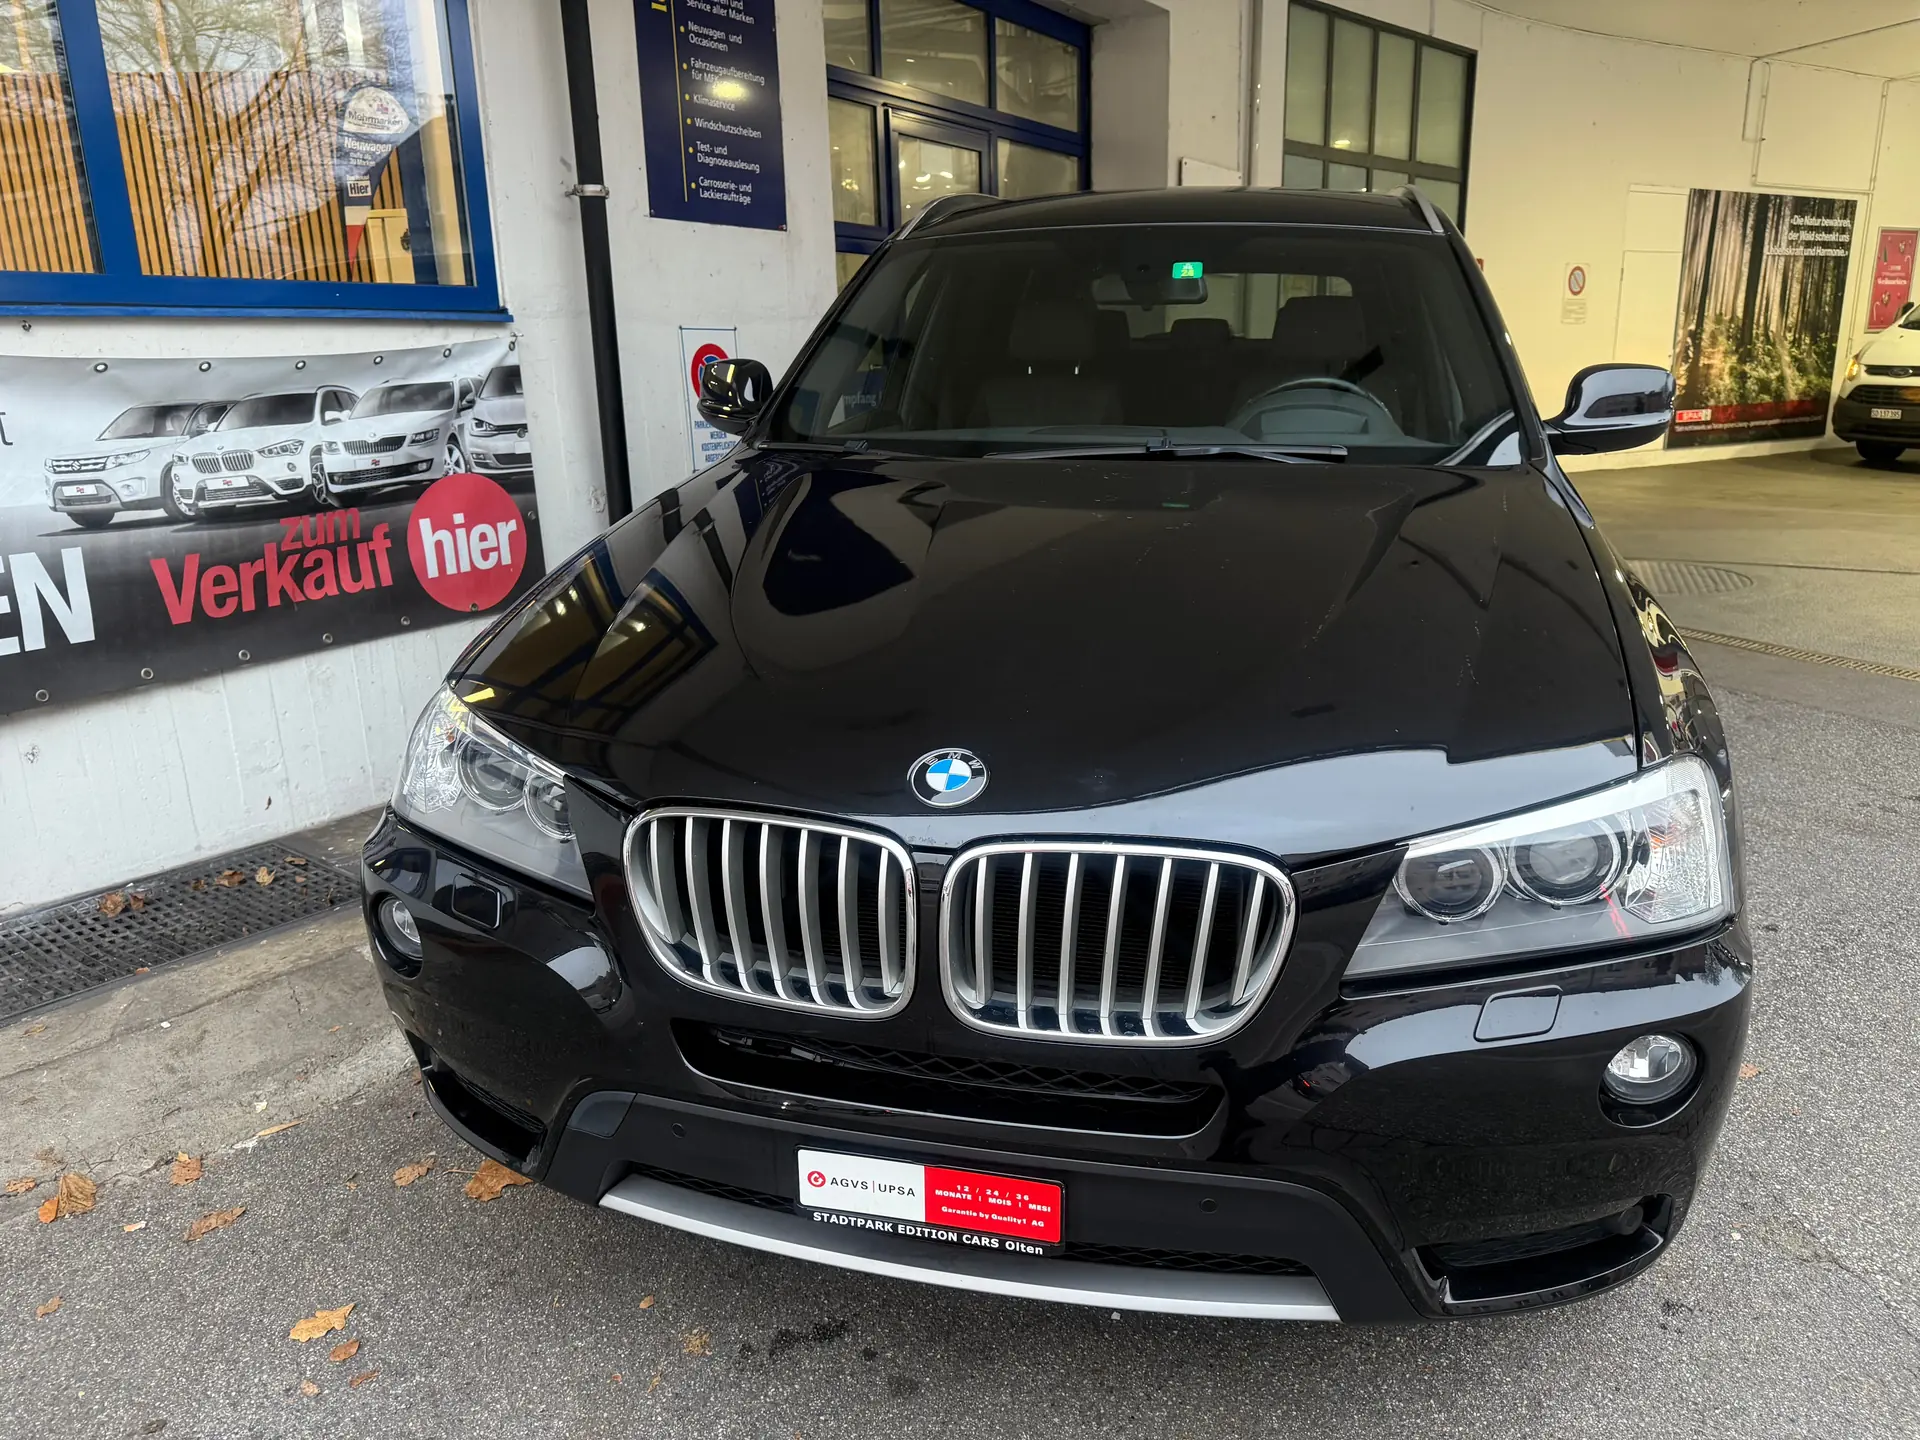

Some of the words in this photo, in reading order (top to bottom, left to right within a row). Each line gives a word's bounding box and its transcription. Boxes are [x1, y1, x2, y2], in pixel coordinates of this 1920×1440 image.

[686, 0, 712, 12] Service
[712, 4, 728, 16] aller
[729, 9, 754, 24] Marken
[688, 21, 726, 40] Neuwagen
[728, 34, 742, 44] und
[688, 33, 728, 52] Occasionen
[690, 58, 765, 86] Fahrzeugaufbereitung
[692, 72, 702, 82] für
[693, 94, 736, 112] Klimaservice
[348, 110, 403, 125] Mehrmarken
[694, 117, 762, 139] Windschutzscheiben
[344, 136, 392, 154] Neuwagen
[696, 141, 713, 153] Test-
[714, 146, 728, 156] und
[696, 154, 760, 174] Diagnoseauslesung
[350, 182, 369, 195] Hier
[698, 176, 738, 191] Carrosserie-
[738, 182, 752, 193] und
[700, 188, 751, 206] Lackieraufträge
[1804, 216, 1821, 226] Natur
[1788, 230, 1799, 240] der
[1800, 231, 1814, 240] Wald
[1816, 232, 1838, 242] schenkt
[1839, 234, 1850, 242] uns
[1804, 246, 1816, 256] und
[278, 508, 362, 552] zum
[149, 522, 393, 625] Verkauf
[418, 512, 518, 580] hier
[830, 1176, 869, 1190] AGVS
[878, 1183, 916, 1198] UPSA
[935, 1189, 972, 1200] MONATE
[988, 1197, 1012, 1206] MOIS
[1028, 1203, 1051, 1212] MESI
[941, 1206, 977, 1217] Garantie
[979, 1212, 990, 1220] by
[991, 1213, 1027, 1224] Quality1
[813, 1211, 893, 1232] STADTPARK
[897, 1224, 958, 1242] EDITION
[962, 1234, 1000, 1248] CARS
[1005, 1240, 1043, 1255] Olten
